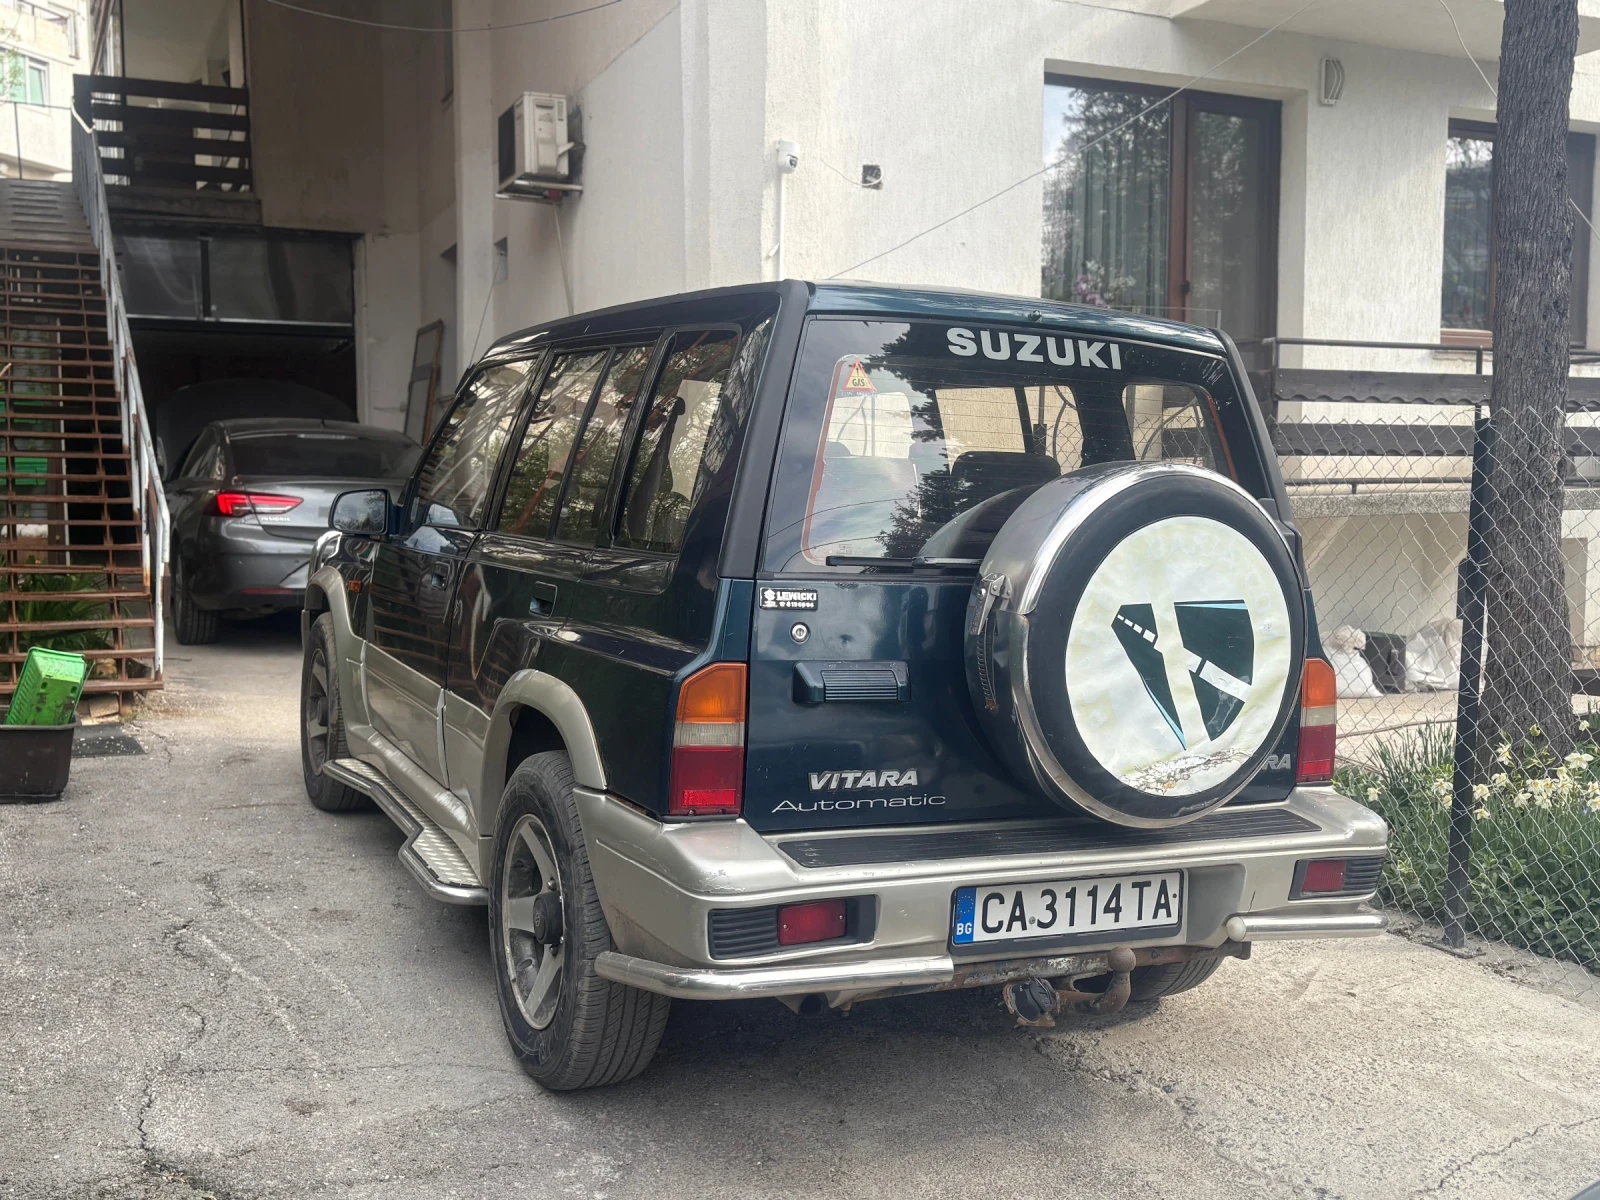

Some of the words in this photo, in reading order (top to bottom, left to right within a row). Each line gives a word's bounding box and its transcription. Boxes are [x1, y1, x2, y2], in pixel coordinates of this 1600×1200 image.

[946, 327, 1122, 370] SUZUKI
[852, 378, 865, 387] GAS
[776, 591, 817, 601] LEWICKI
[809, 769, 919, 791] VITARA
[771, 794, 947, 813] Automatic
[956, 922, 973, 936] BG
